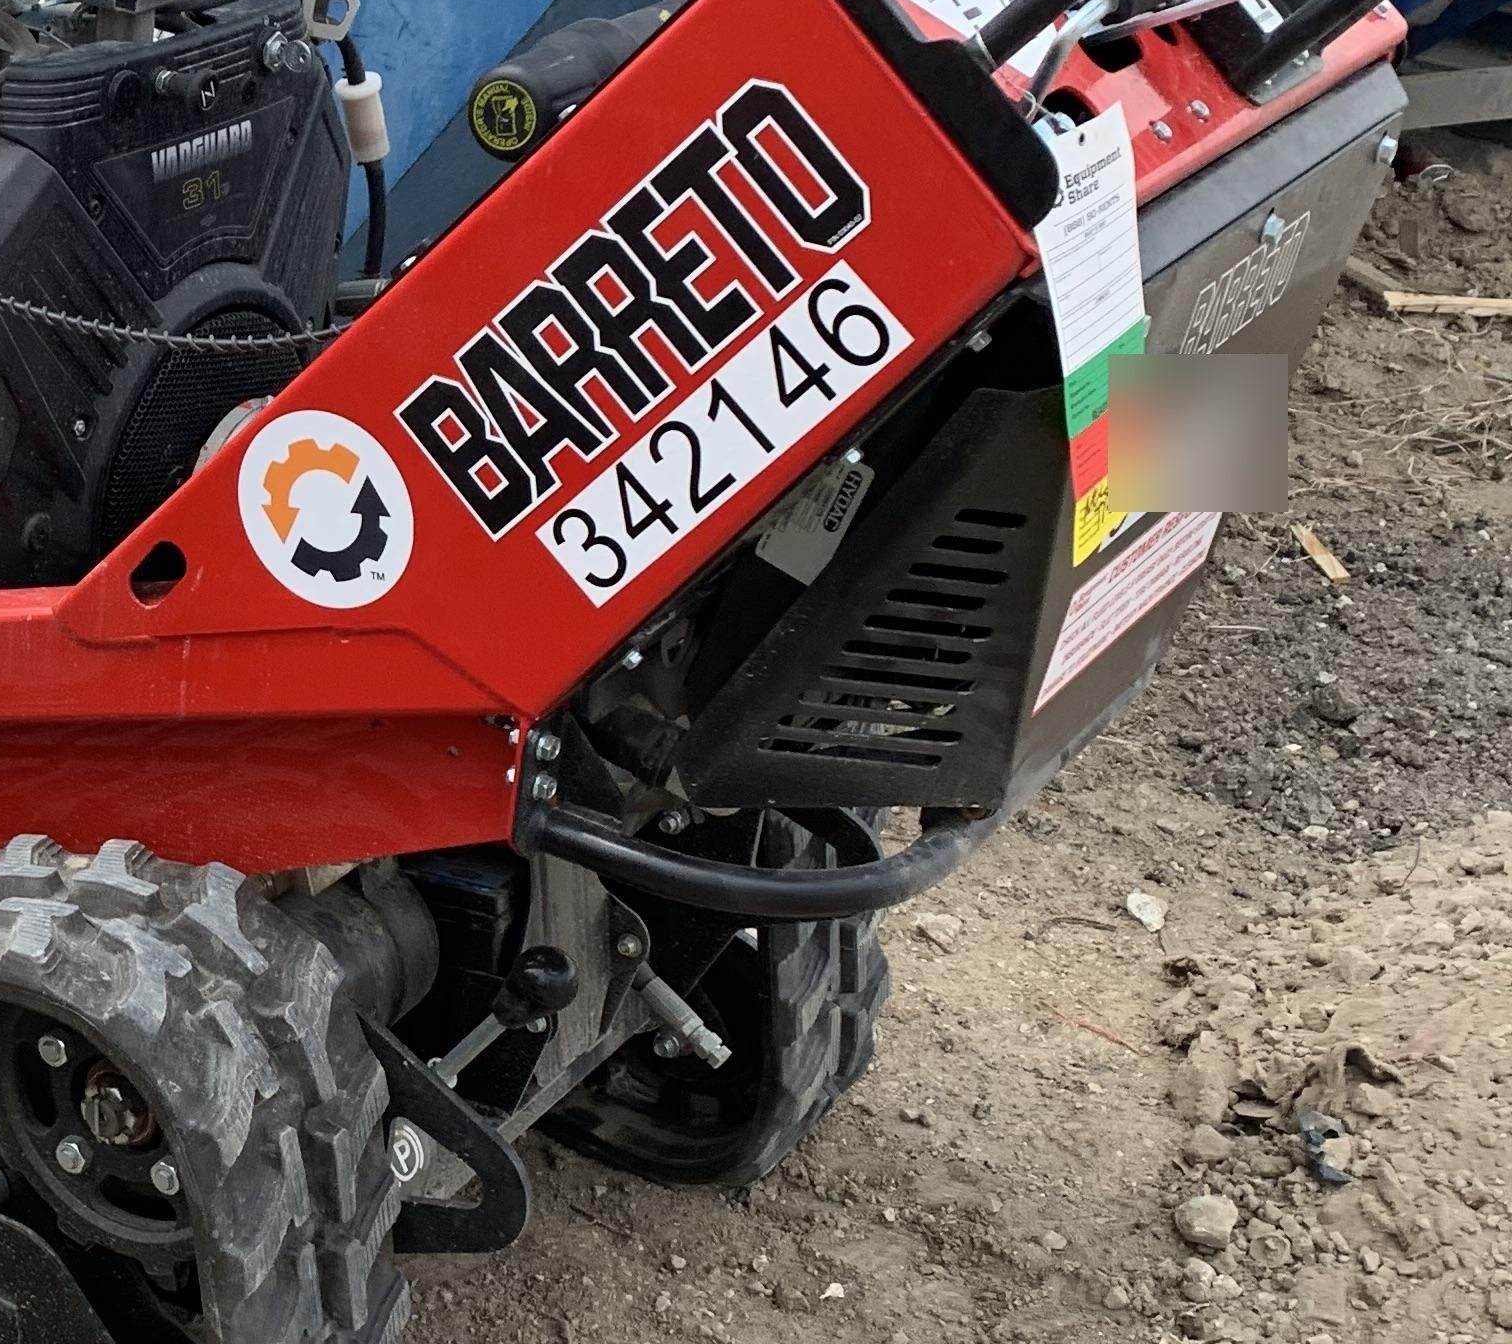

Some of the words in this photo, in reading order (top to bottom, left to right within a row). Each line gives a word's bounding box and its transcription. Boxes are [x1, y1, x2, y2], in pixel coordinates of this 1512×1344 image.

[151, 119, 253, 183] VANGUARD
[1064, 146, 1122, 189] Equipment
[182, 170, 221, 210] 31
[1068, 180, 1100, 205] Share
[394, 78, 871, 542] BARRETO
[551, 277, 891, 589] 342146
[825, 472, 862, 531] HYDAC
[370, 571, 386, 581] TM
